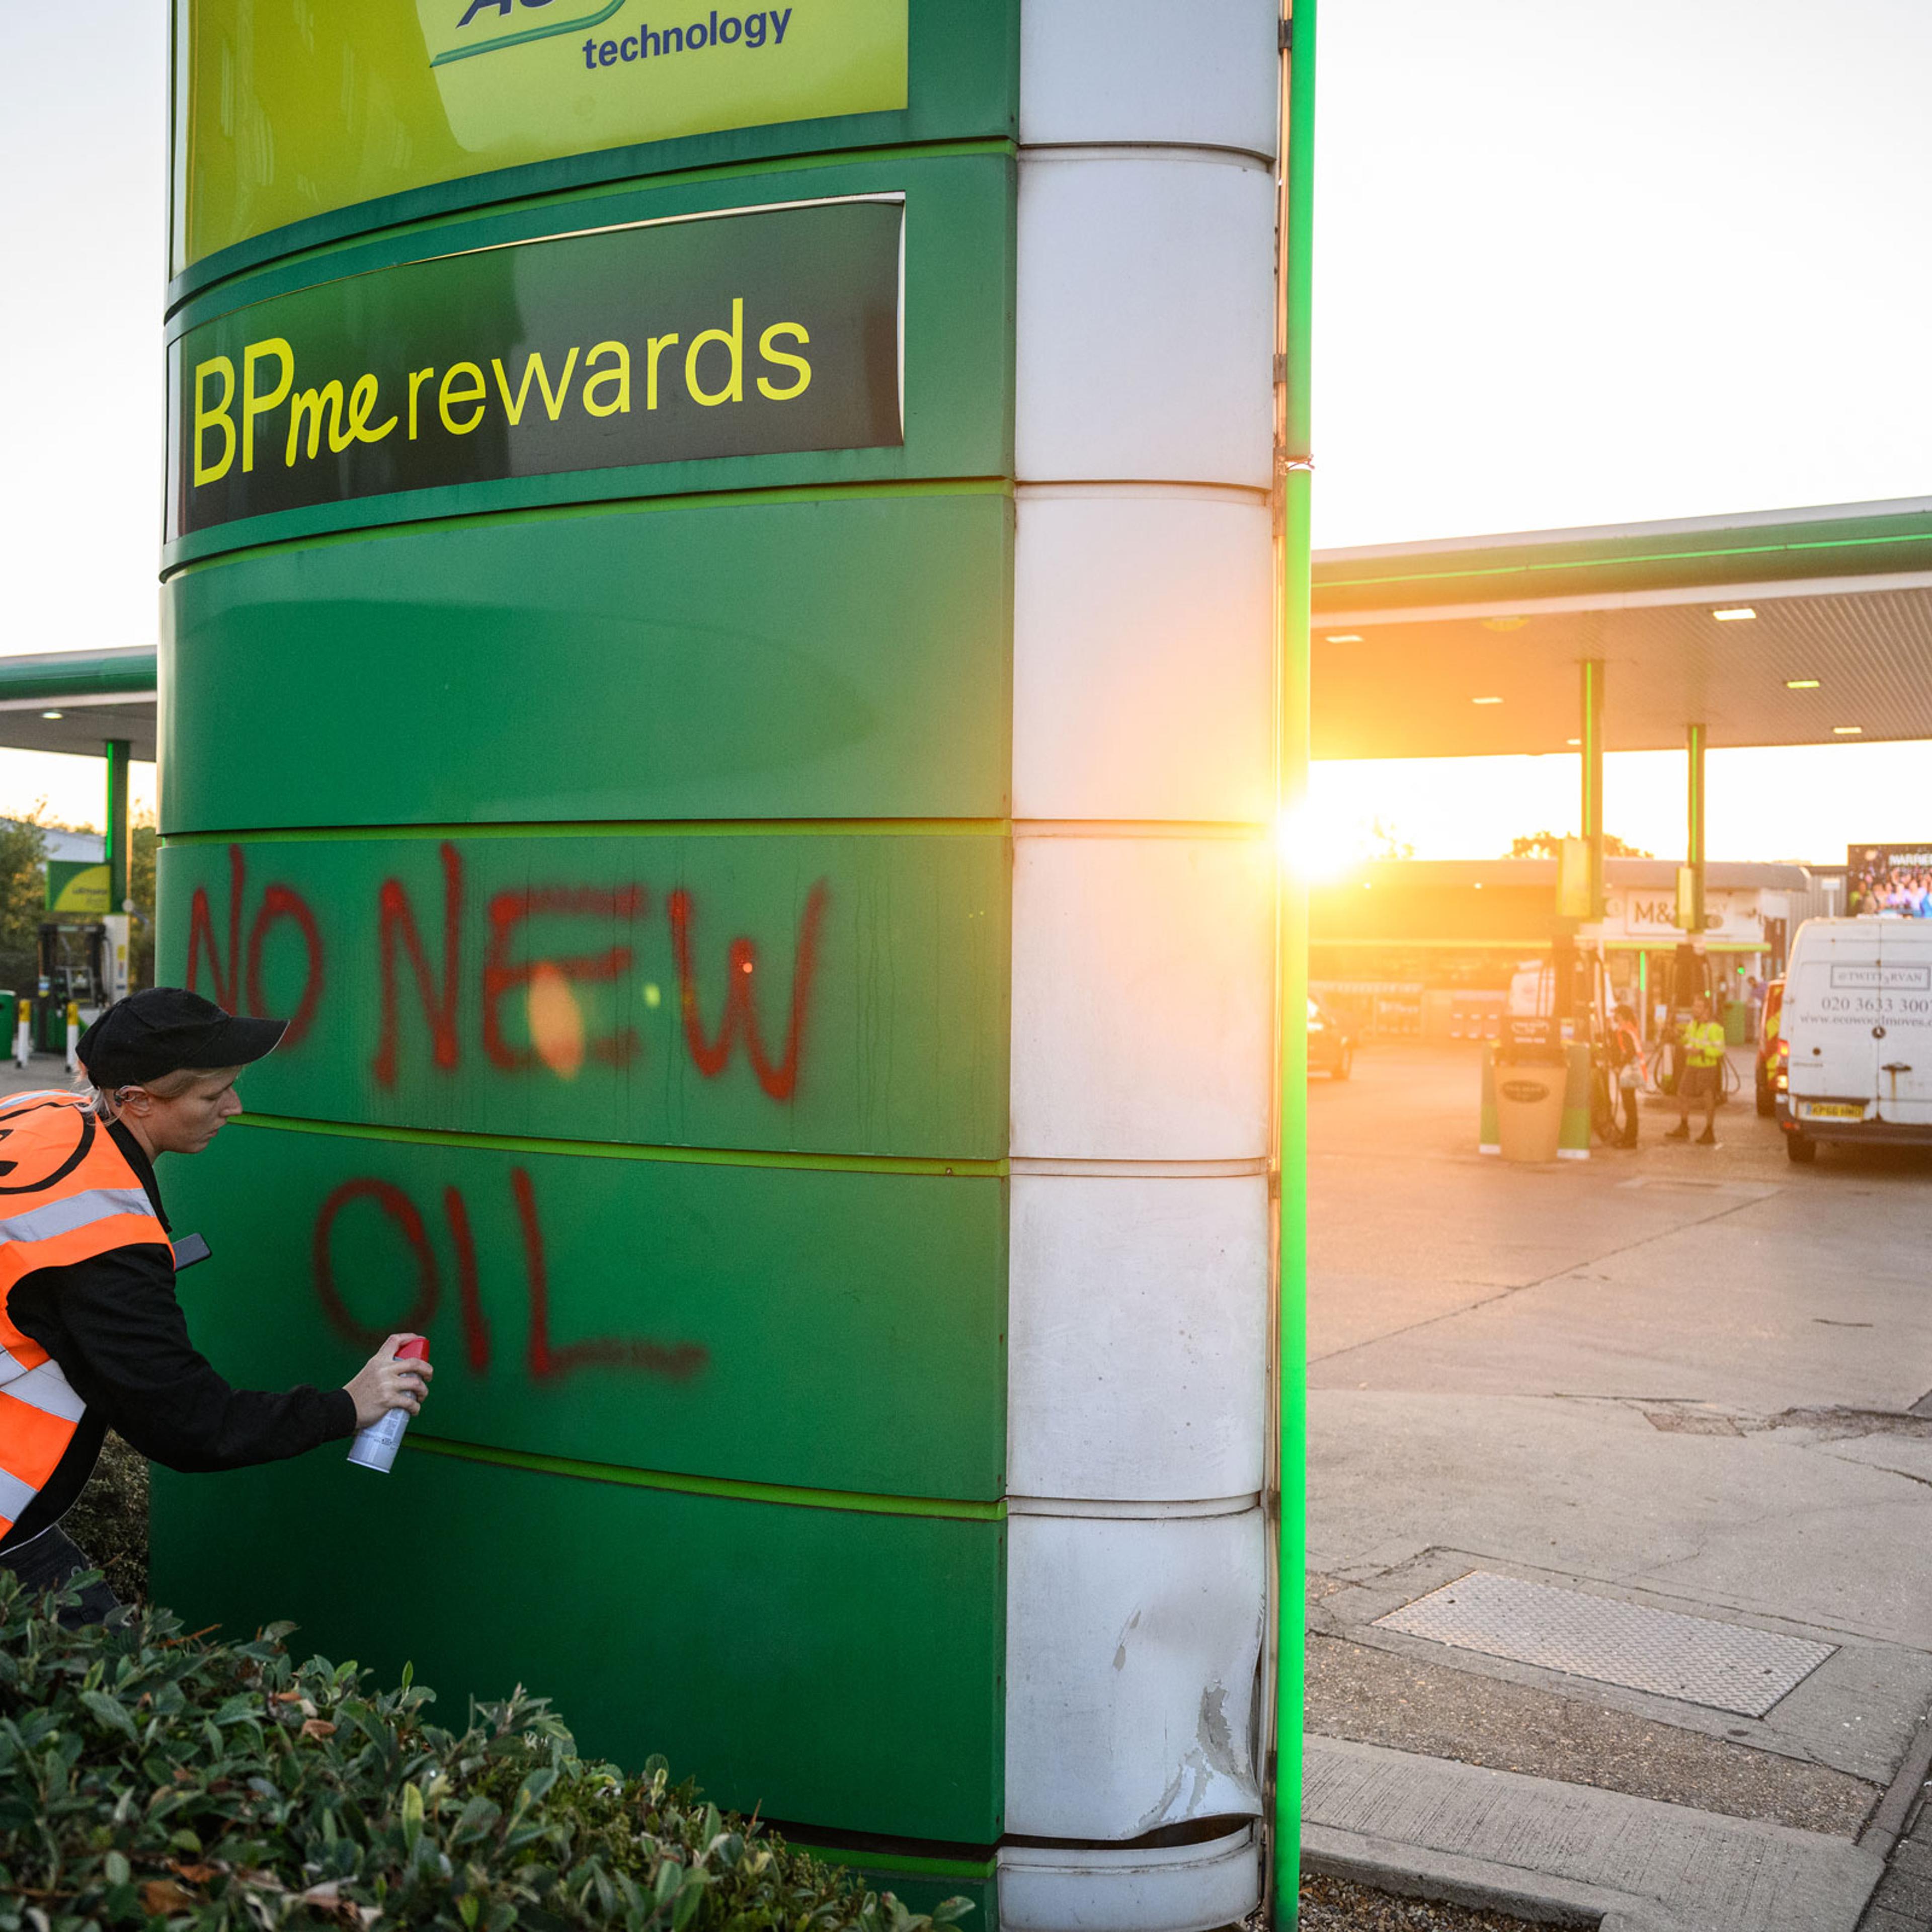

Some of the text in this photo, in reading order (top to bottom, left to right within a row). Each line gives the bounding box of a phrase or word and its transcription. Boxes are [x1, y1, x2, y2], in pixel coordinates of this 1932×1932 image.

[583, 8, 792, 69] technology
[409, 297, 812, 440] rewards
[185, 840, 829, 1102] NO NEW
[1821, 996, 1850, 1010] 020
[1855, 997, 1893, 1012] 3633
[311, 1166, 709, 1388] OIL
